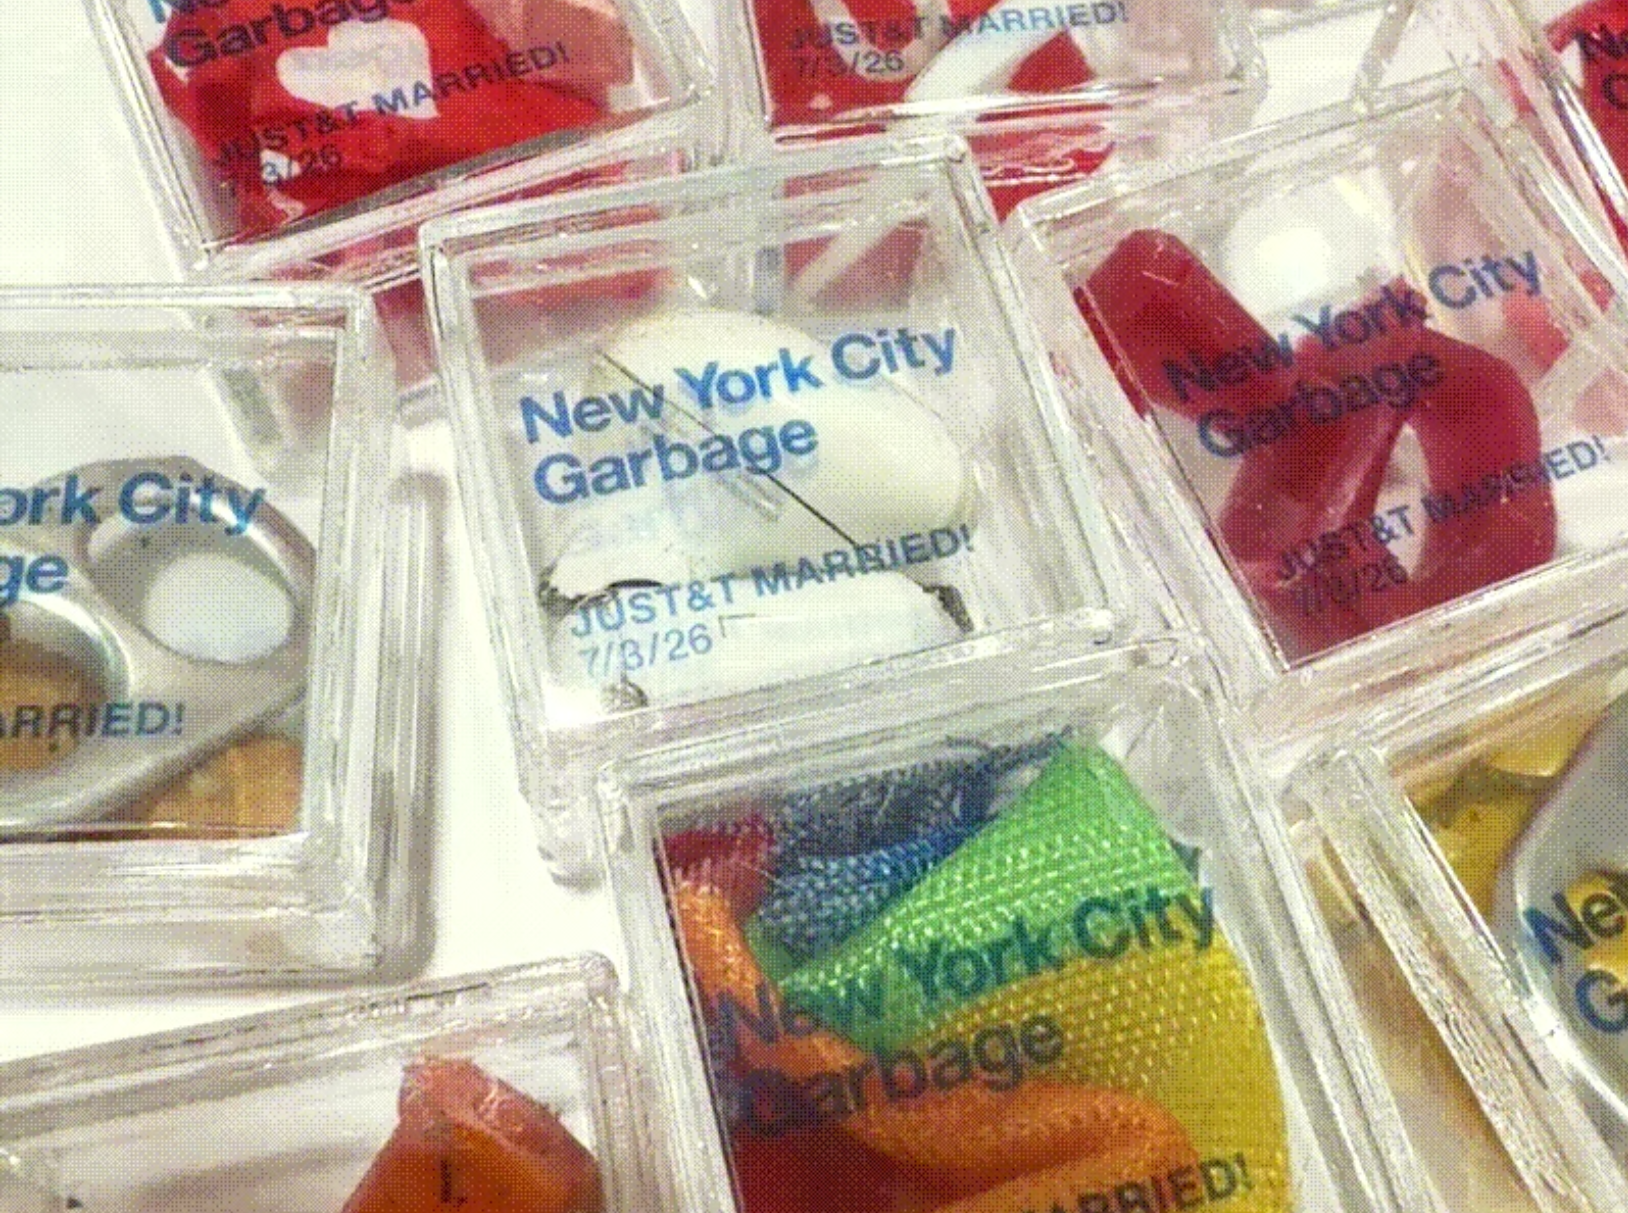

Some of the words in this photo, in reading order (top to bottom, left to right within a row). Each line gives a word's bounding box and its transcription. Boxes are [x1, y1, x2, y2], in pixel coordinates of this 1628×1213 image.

[163, 0, 408, 67] Garbag
[939, 2, 1128, 40] MARRIED!
[371, 41, 570, 115] MARRIED!
[1162, 333, 1295, 400] New
[1294, 284, 1429, 351] York
[1428, 250, 1542, 308] City
[519, 385, 666, 444] New
[675, 347, 823, 409] York
[831, 328, 956, 380] City
[1198, 352, 1445, 458] Garbage
[118, 472, 267, 534] City
[533, 418, 819, 505] Garbage
[1277, 505, 1414, 580] JUST&T
[1421, 435, 1611, 521] MARRIED!
[571, 572, 735, 638] JUST&T
[752, 523, 975, 598] MARRIED!
[579, 622, 713, 679] 7/3/26
[0, 702, 185, 736] RRIED!
[716, 970, 886, 1045] New
[892, 916, 1062, 1000] York
[1073, 886, 1215, 957] City
[744, 1014, 1064, 1136] Garbage
